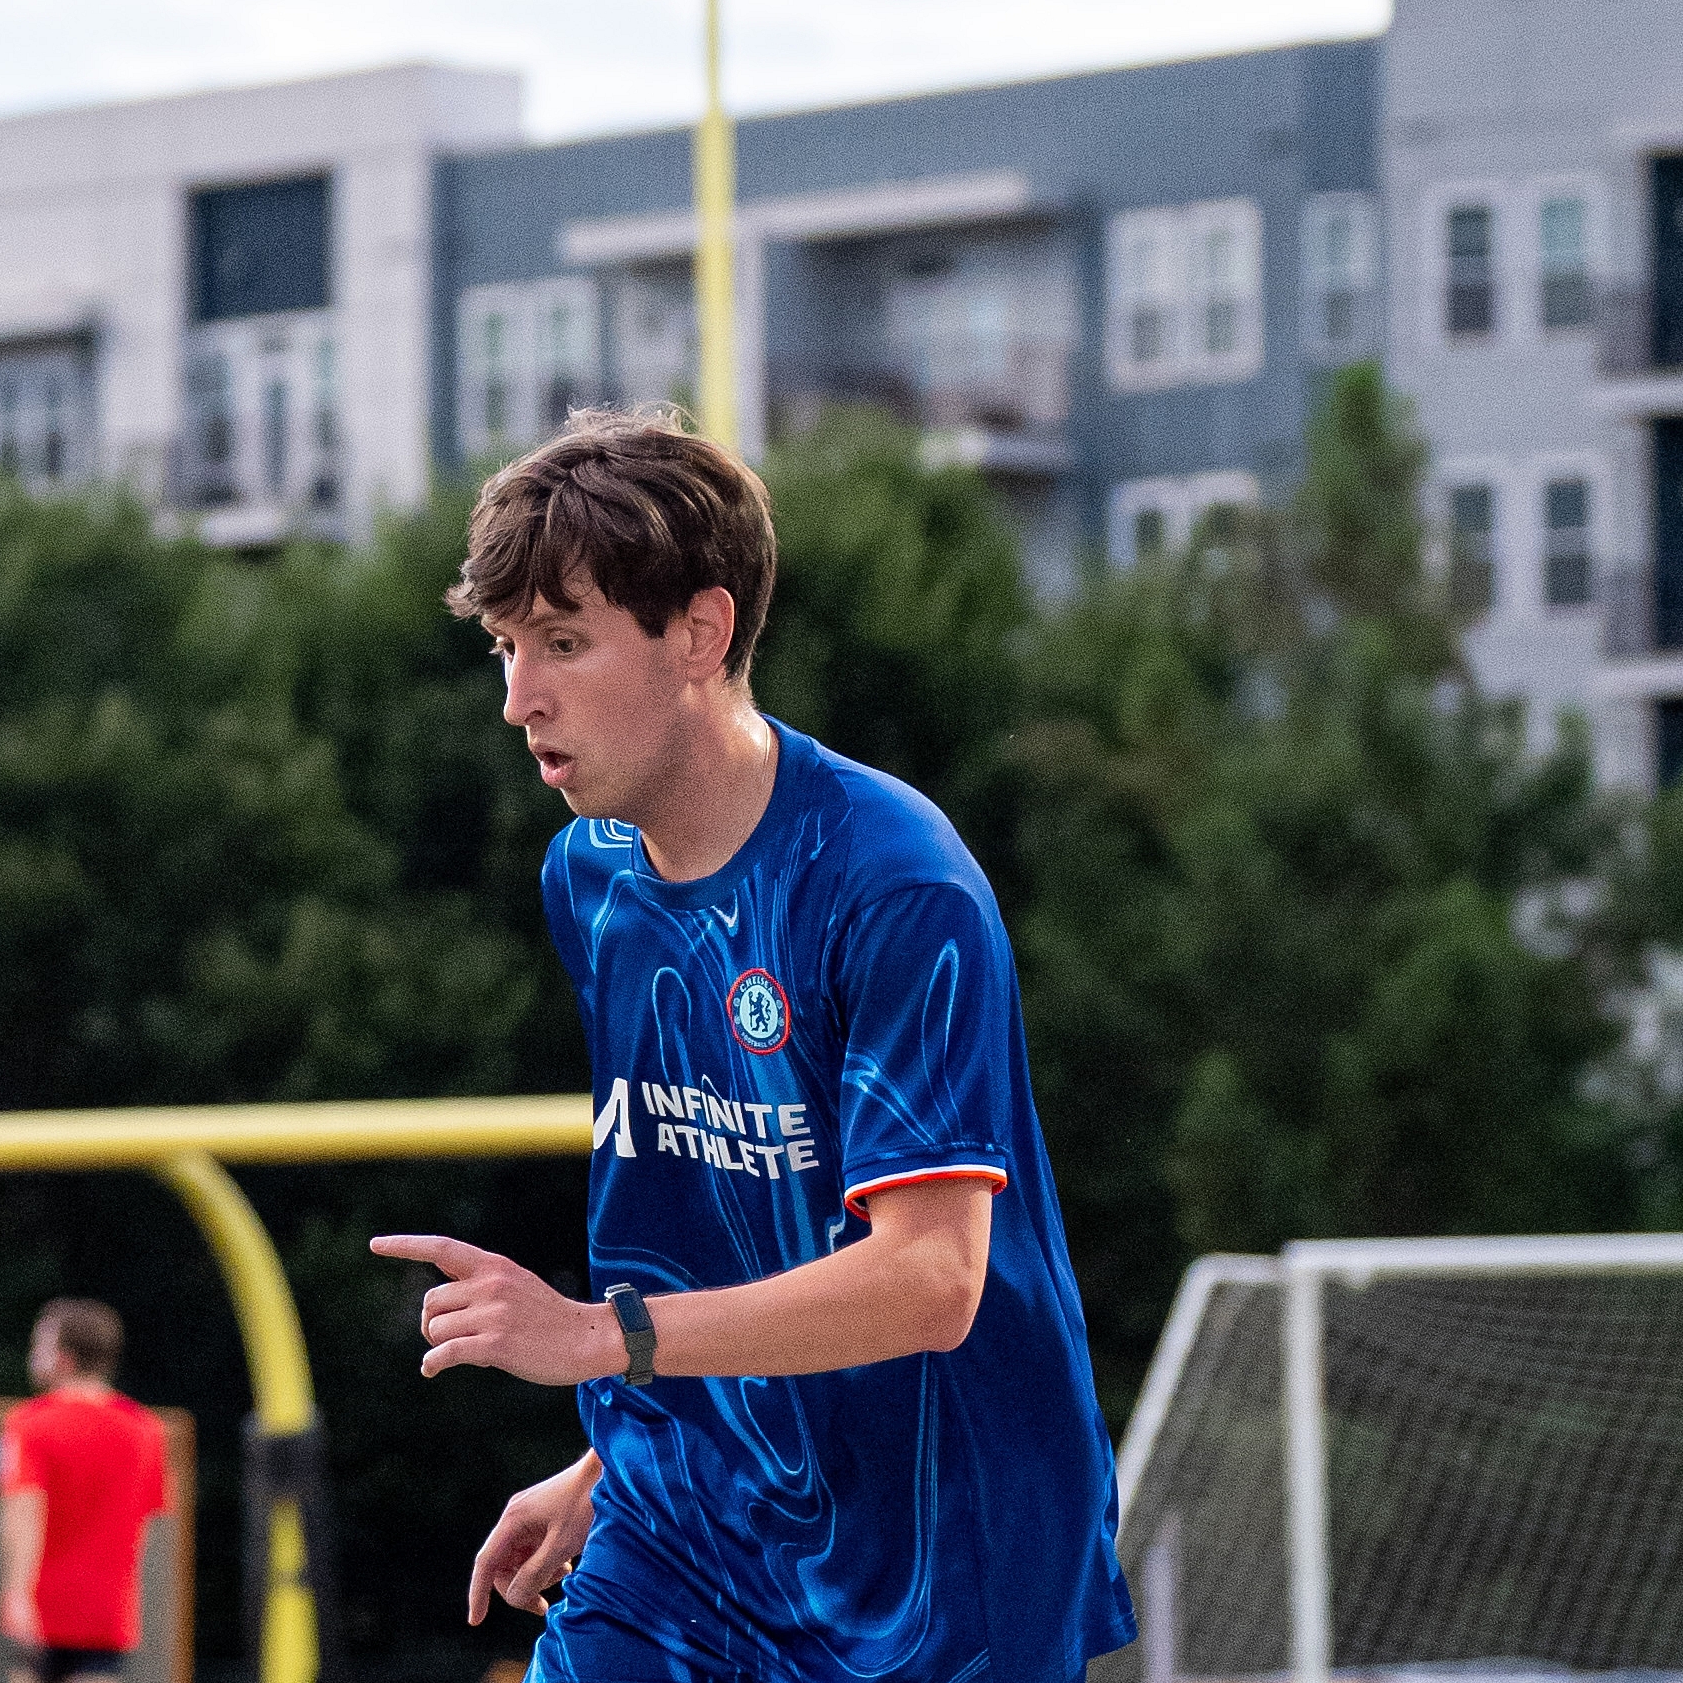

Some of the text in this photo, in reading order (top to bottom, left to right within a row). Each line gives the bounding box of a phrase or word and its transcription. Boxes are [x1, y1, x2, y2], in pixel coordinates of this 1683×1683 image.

[739, 975, 776, 994] CHELSEA
[641, 1080, 811, 1139] INFINITE
[657, 1122, 819, 1180] ATHLETE
